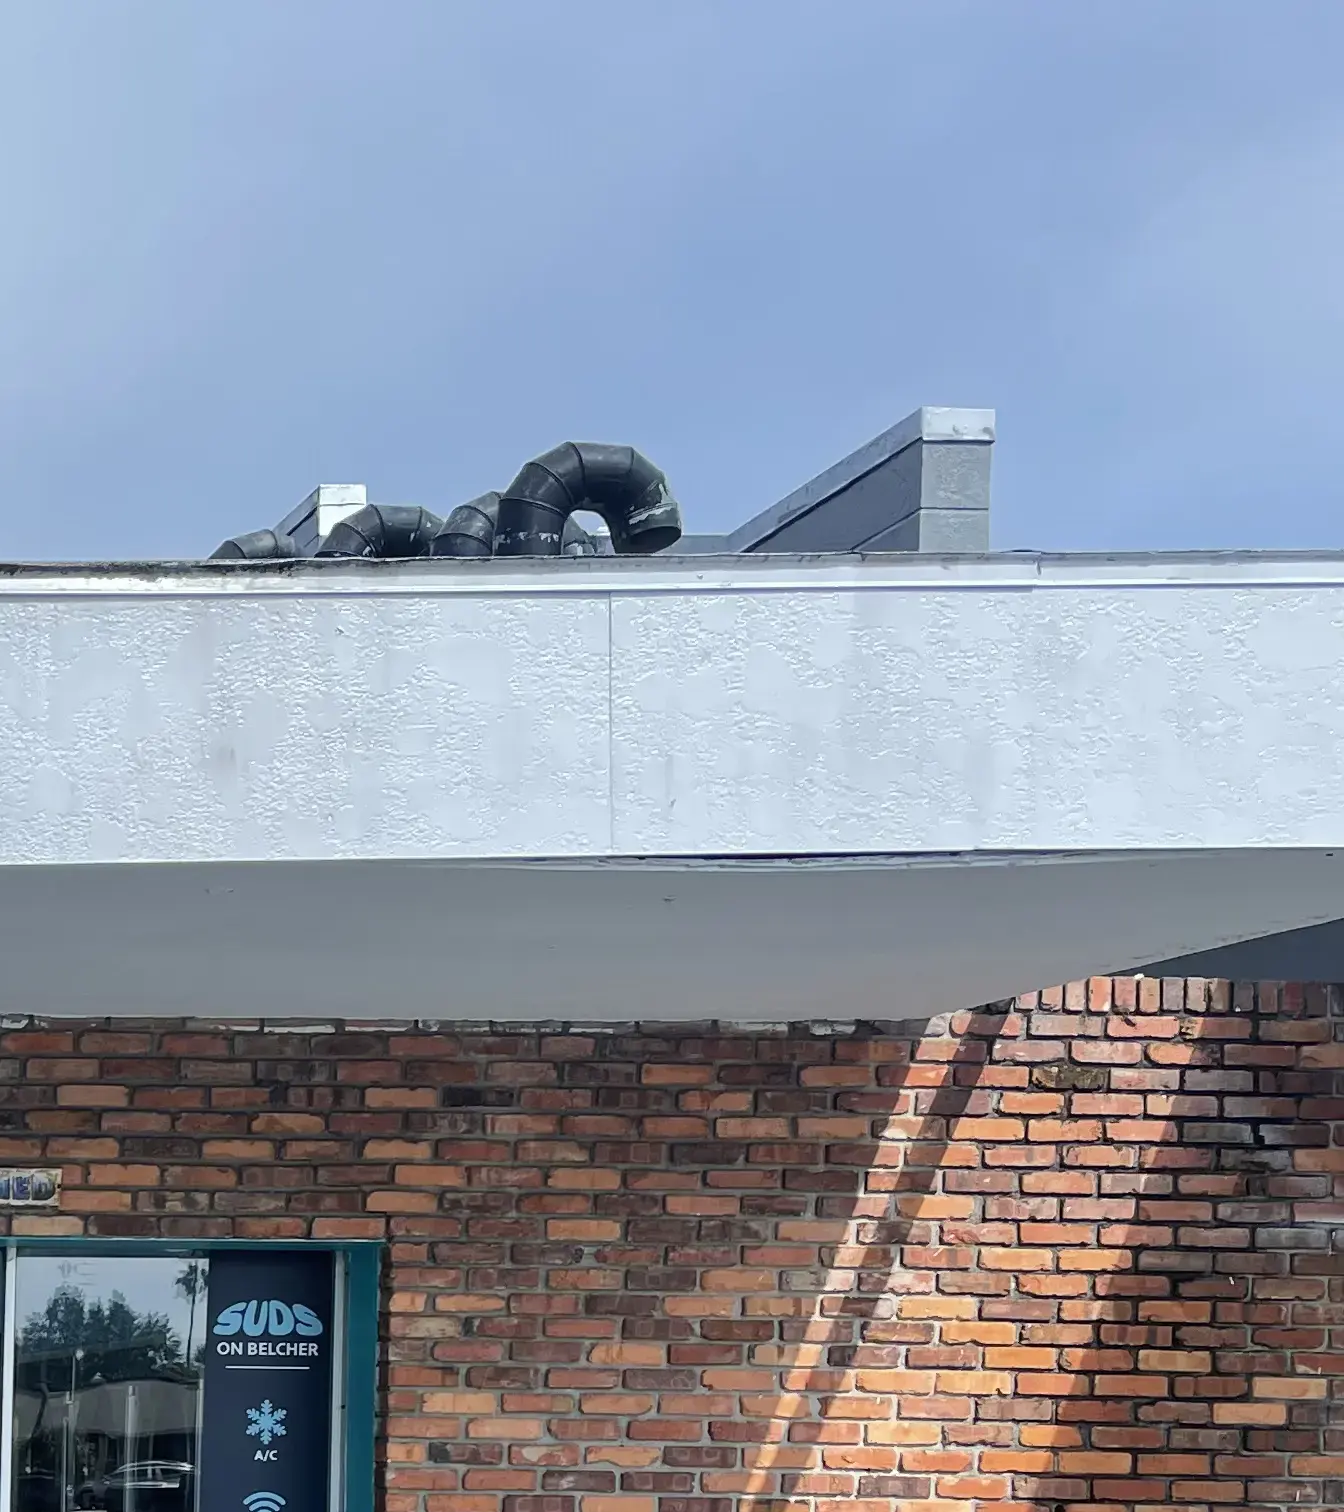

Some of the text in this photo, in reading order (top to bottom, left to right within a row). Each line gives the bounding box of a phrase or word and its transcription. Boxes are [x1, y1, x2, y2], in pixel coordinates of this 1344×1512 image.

[212, 1300, 324, 1337] SUDS
[216, 1342, 319, 1357] ON BELCHER
[253, 1449, 278, 1462] A/C
